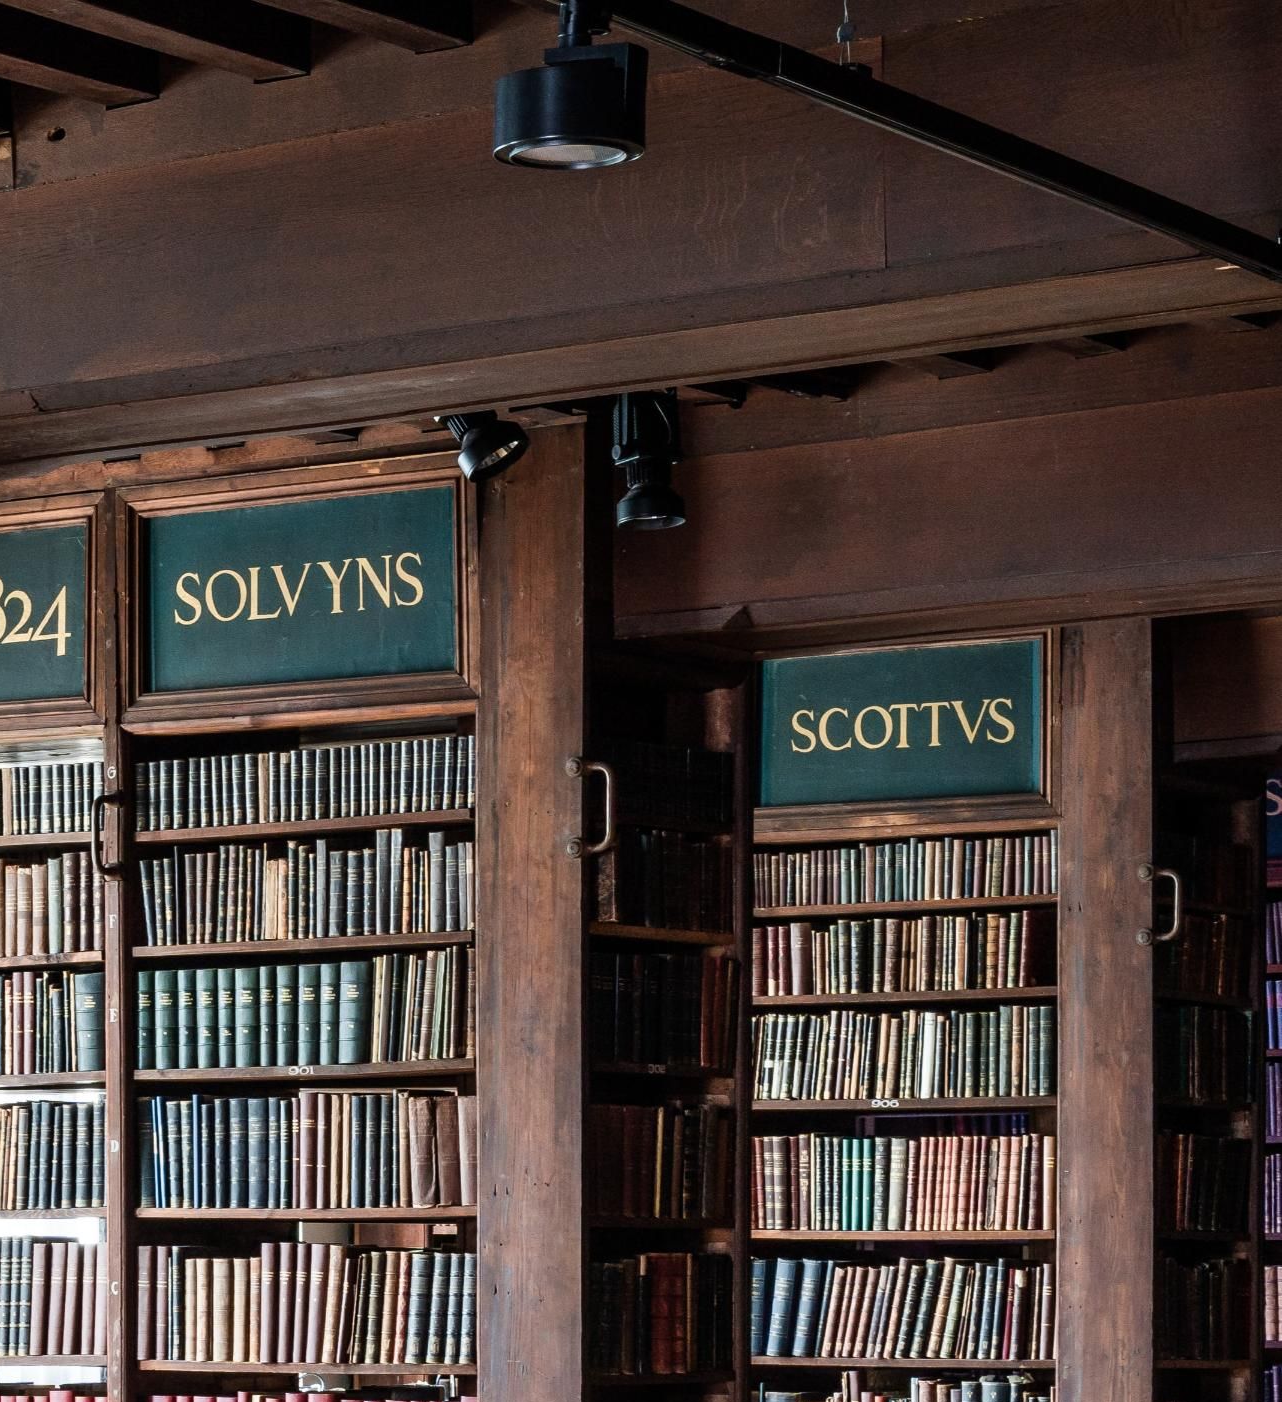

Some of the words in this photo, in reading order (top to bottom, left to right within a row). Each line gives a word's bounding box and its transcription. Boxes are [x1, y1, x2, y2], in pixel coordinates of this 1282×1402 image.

[174, 551, 424, 627] SOLVYNS
[791, 697, 1015, 753] SCOTTVS
[106, 766, 116, 779] G
[288, 1065, 314, 1075] 901
